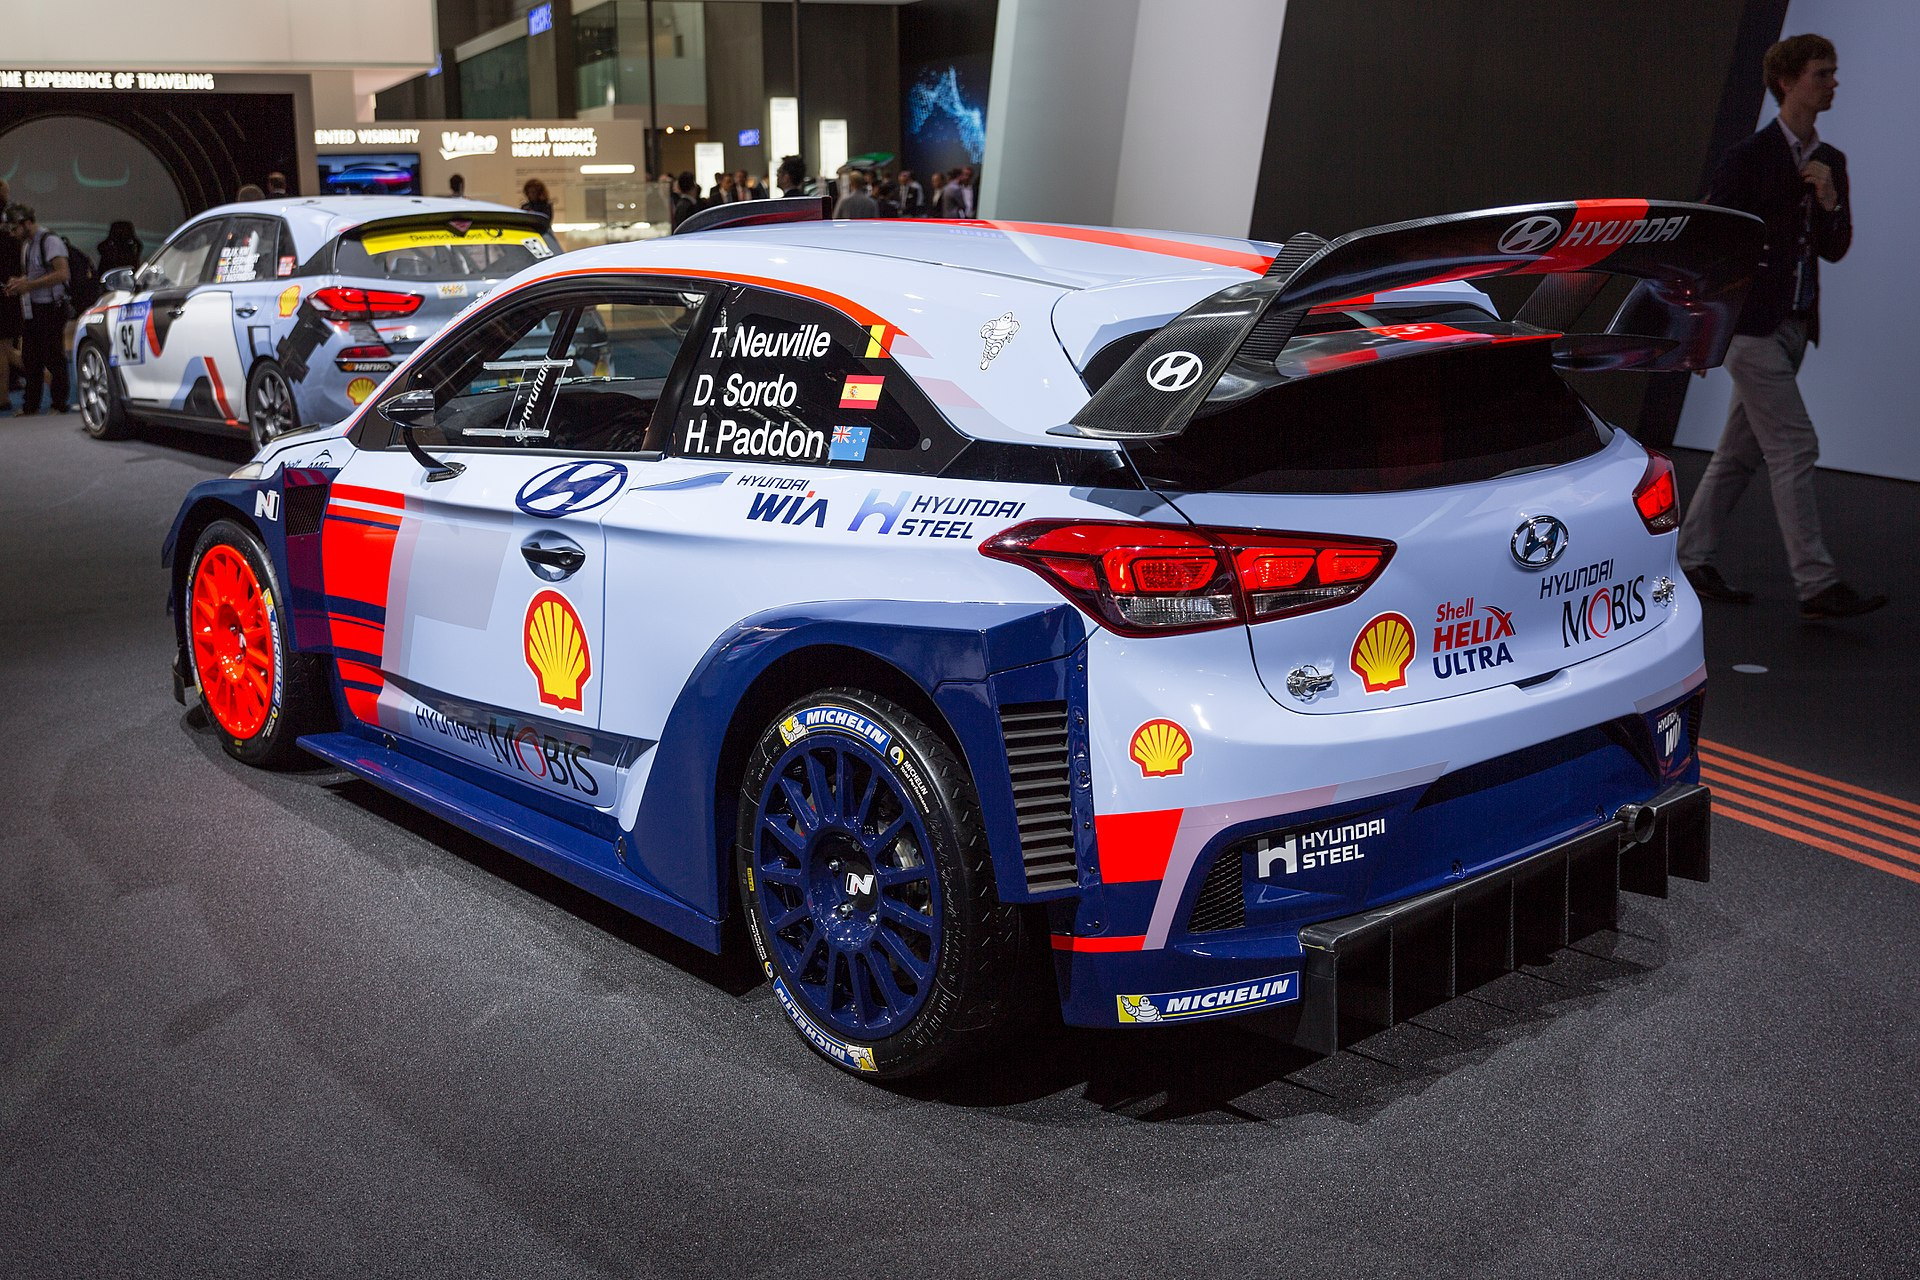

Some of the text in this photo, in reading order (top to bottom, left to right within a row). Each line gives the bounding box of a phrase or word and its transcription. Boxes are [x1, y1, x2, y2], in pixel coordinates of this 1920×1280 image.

[24, 71, 113, 89] EXPERIENCE
[114, 73, 136, 89] OF
[136, 73, 215, 90] TRAVELING
[357, 128, 420, 144] VISIBILITY
[441, 131, 498, 155] Valeo
[511, 127, 546, 143] LIGHT
[511, 141, 597, 157] HEAVY IMPACT
[1559, 215, 1690, 247] HYUNDAI
[121, 324, 138, 360] 92
[709, 324, 831, 358] T. Neuville
[692, 373, 797, 407] D. Sordo
[683, 419, 824, 459] H. Paddon
[736, 475, 810, 491] HYUNDAI
[746, 490, 829, 528] WIA
[910, 495, 1026, 520] HYUNDAI
[898, 519, 975, 540] STEEL
[1539, 558, 1614, 600] HYUNDAI
[1435, 597, 1474, 623] Shell
[1563, 575, 1646, 648] MOBIS
[1433, 608, 1515, 653] HELIX
[1432, 642, 1514, 679] ULTRA
[806, 710, 887, 745] MICHELIN
[415, 705, 599, 796] HYUNDAI MOBIS
[900, 766, 930, 814] Total Performance
[903, 760, 928, 796] MICHELIN
[1302, 818, 1386, 849] HYUNDAI
[1302, 844, 1365, 869] STEEL
[1165, 978, 1290, 1013] MICHELIN
[775, 987, 846, 1062] MICHELIN
